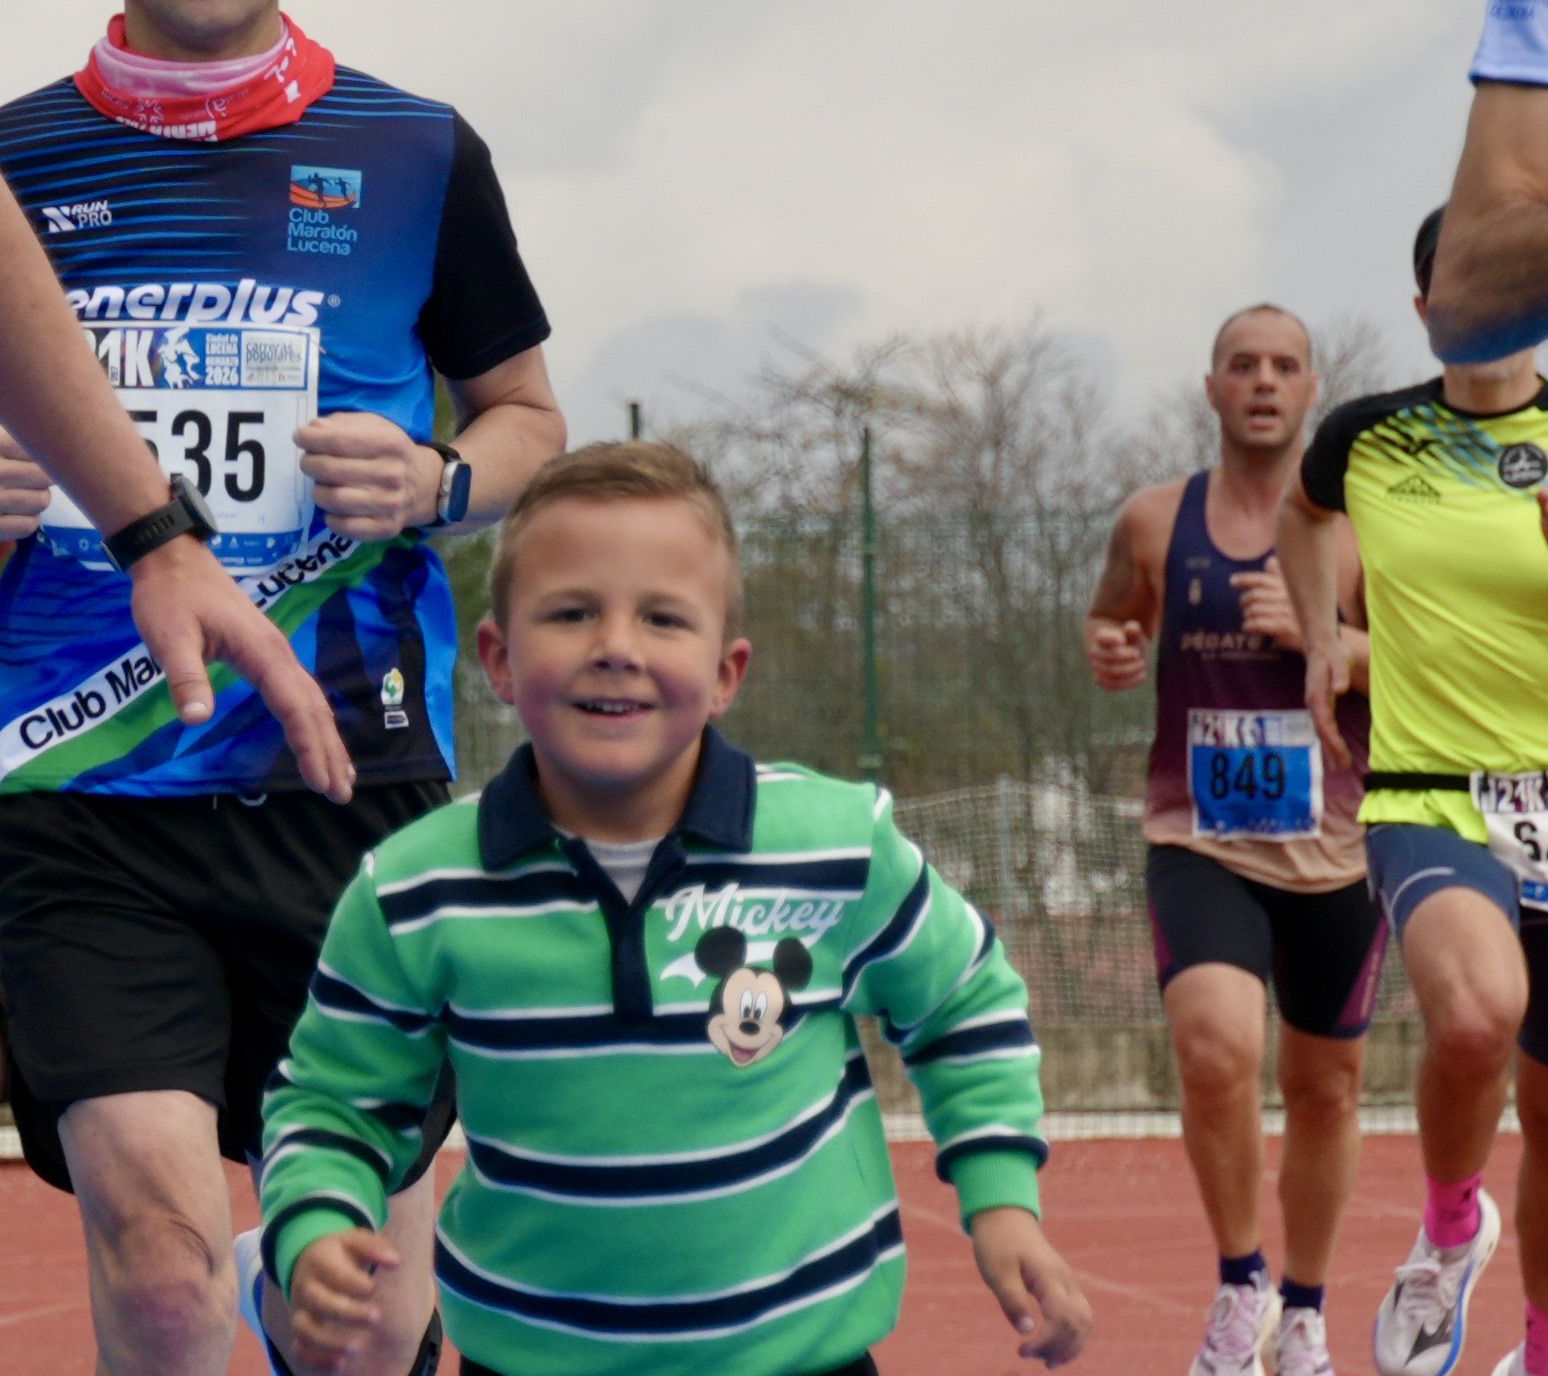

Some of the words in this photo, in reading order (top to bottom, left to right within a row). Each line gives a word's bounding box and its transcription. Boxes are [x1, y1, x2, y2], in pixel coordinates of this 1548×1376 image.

[71, 200, 109, 217] RUN
[77, 209, 113, 228] PRO
[289, 208, 330, 225] Club
[288, 223, 358, 243] Maratón
[287, 239, 351, 257] Lucena
[204, 366, 240, 386] 2026
[19, 689, 105, 751] Club
[1210, 752, 1286, 800] 849
[664, 881, 843, 948] Mickey
